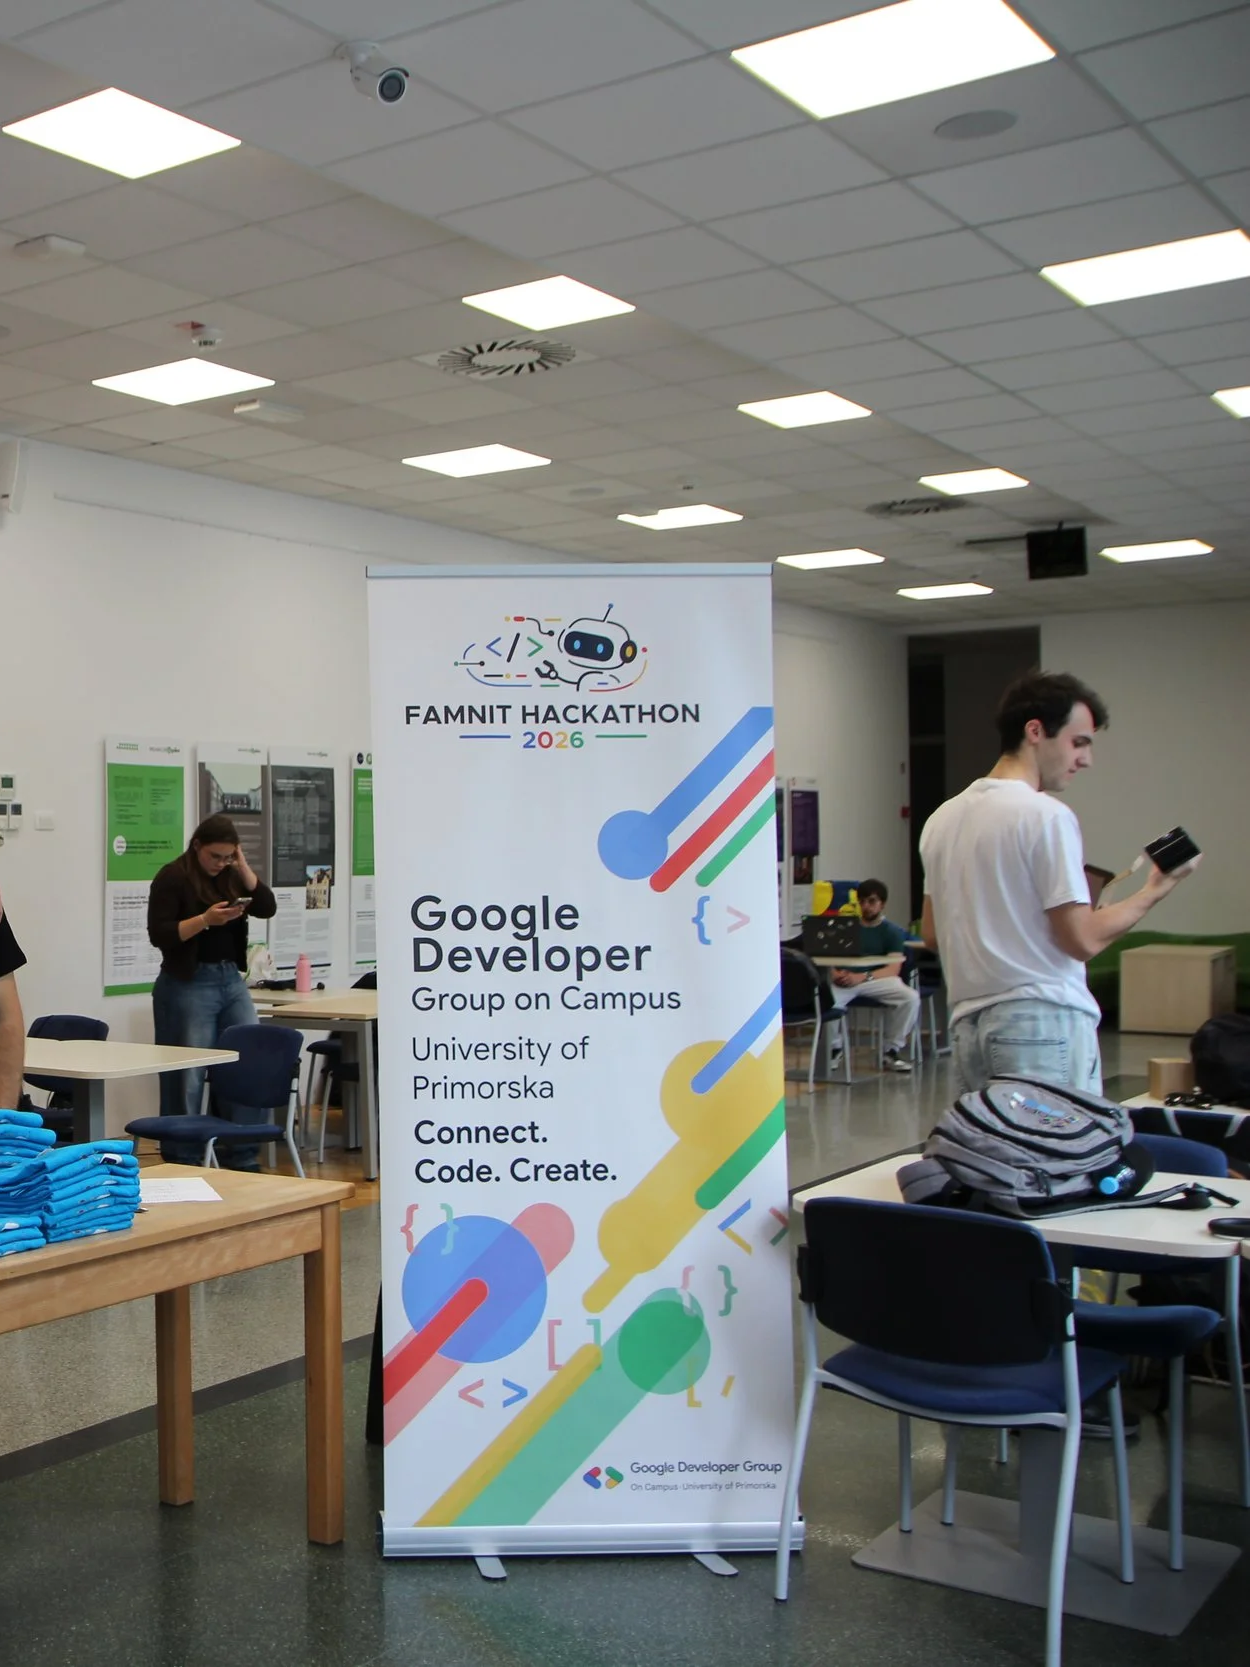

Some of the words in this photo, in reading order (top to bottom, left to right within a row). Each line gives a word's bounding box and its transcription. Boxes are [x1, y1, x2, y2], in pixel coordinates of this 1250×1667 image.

[405, 704, 512, 725] FAMNIT
[521, 703, 700, 725] HACKATHON
[522, 731, 584, 749] 2026
[410, 894, 580, 941] Google
[412, 936, 652, 982] Developer
[411, 986, 505, 1018] Group
[514, 992, 550, 1011] on
[560, 985, 681, 1016] Campus
[412, 1036, 552, 1067] University
[560, 1035, 590, 1060] of
[413, 1075, 554, 1100] Primorska
[414, 1119, 548, 1145] Connect.
[414, 1158, 501, 1184] Code.
[509, 1157, 617, 1183] Create.
[630, 1462, 675, 1476] Google
[678, 1462, 740, 1476] Developer
[742, 1461, 783, 1475] Group
[630, 1482, 643, 1491] On
[645, 1483, 678, 1493] Campus
[683, 1482, 723, 1493] University
[724, 1481, 734, 1491] of
[735, 1481, 777, 1490] Primorska
